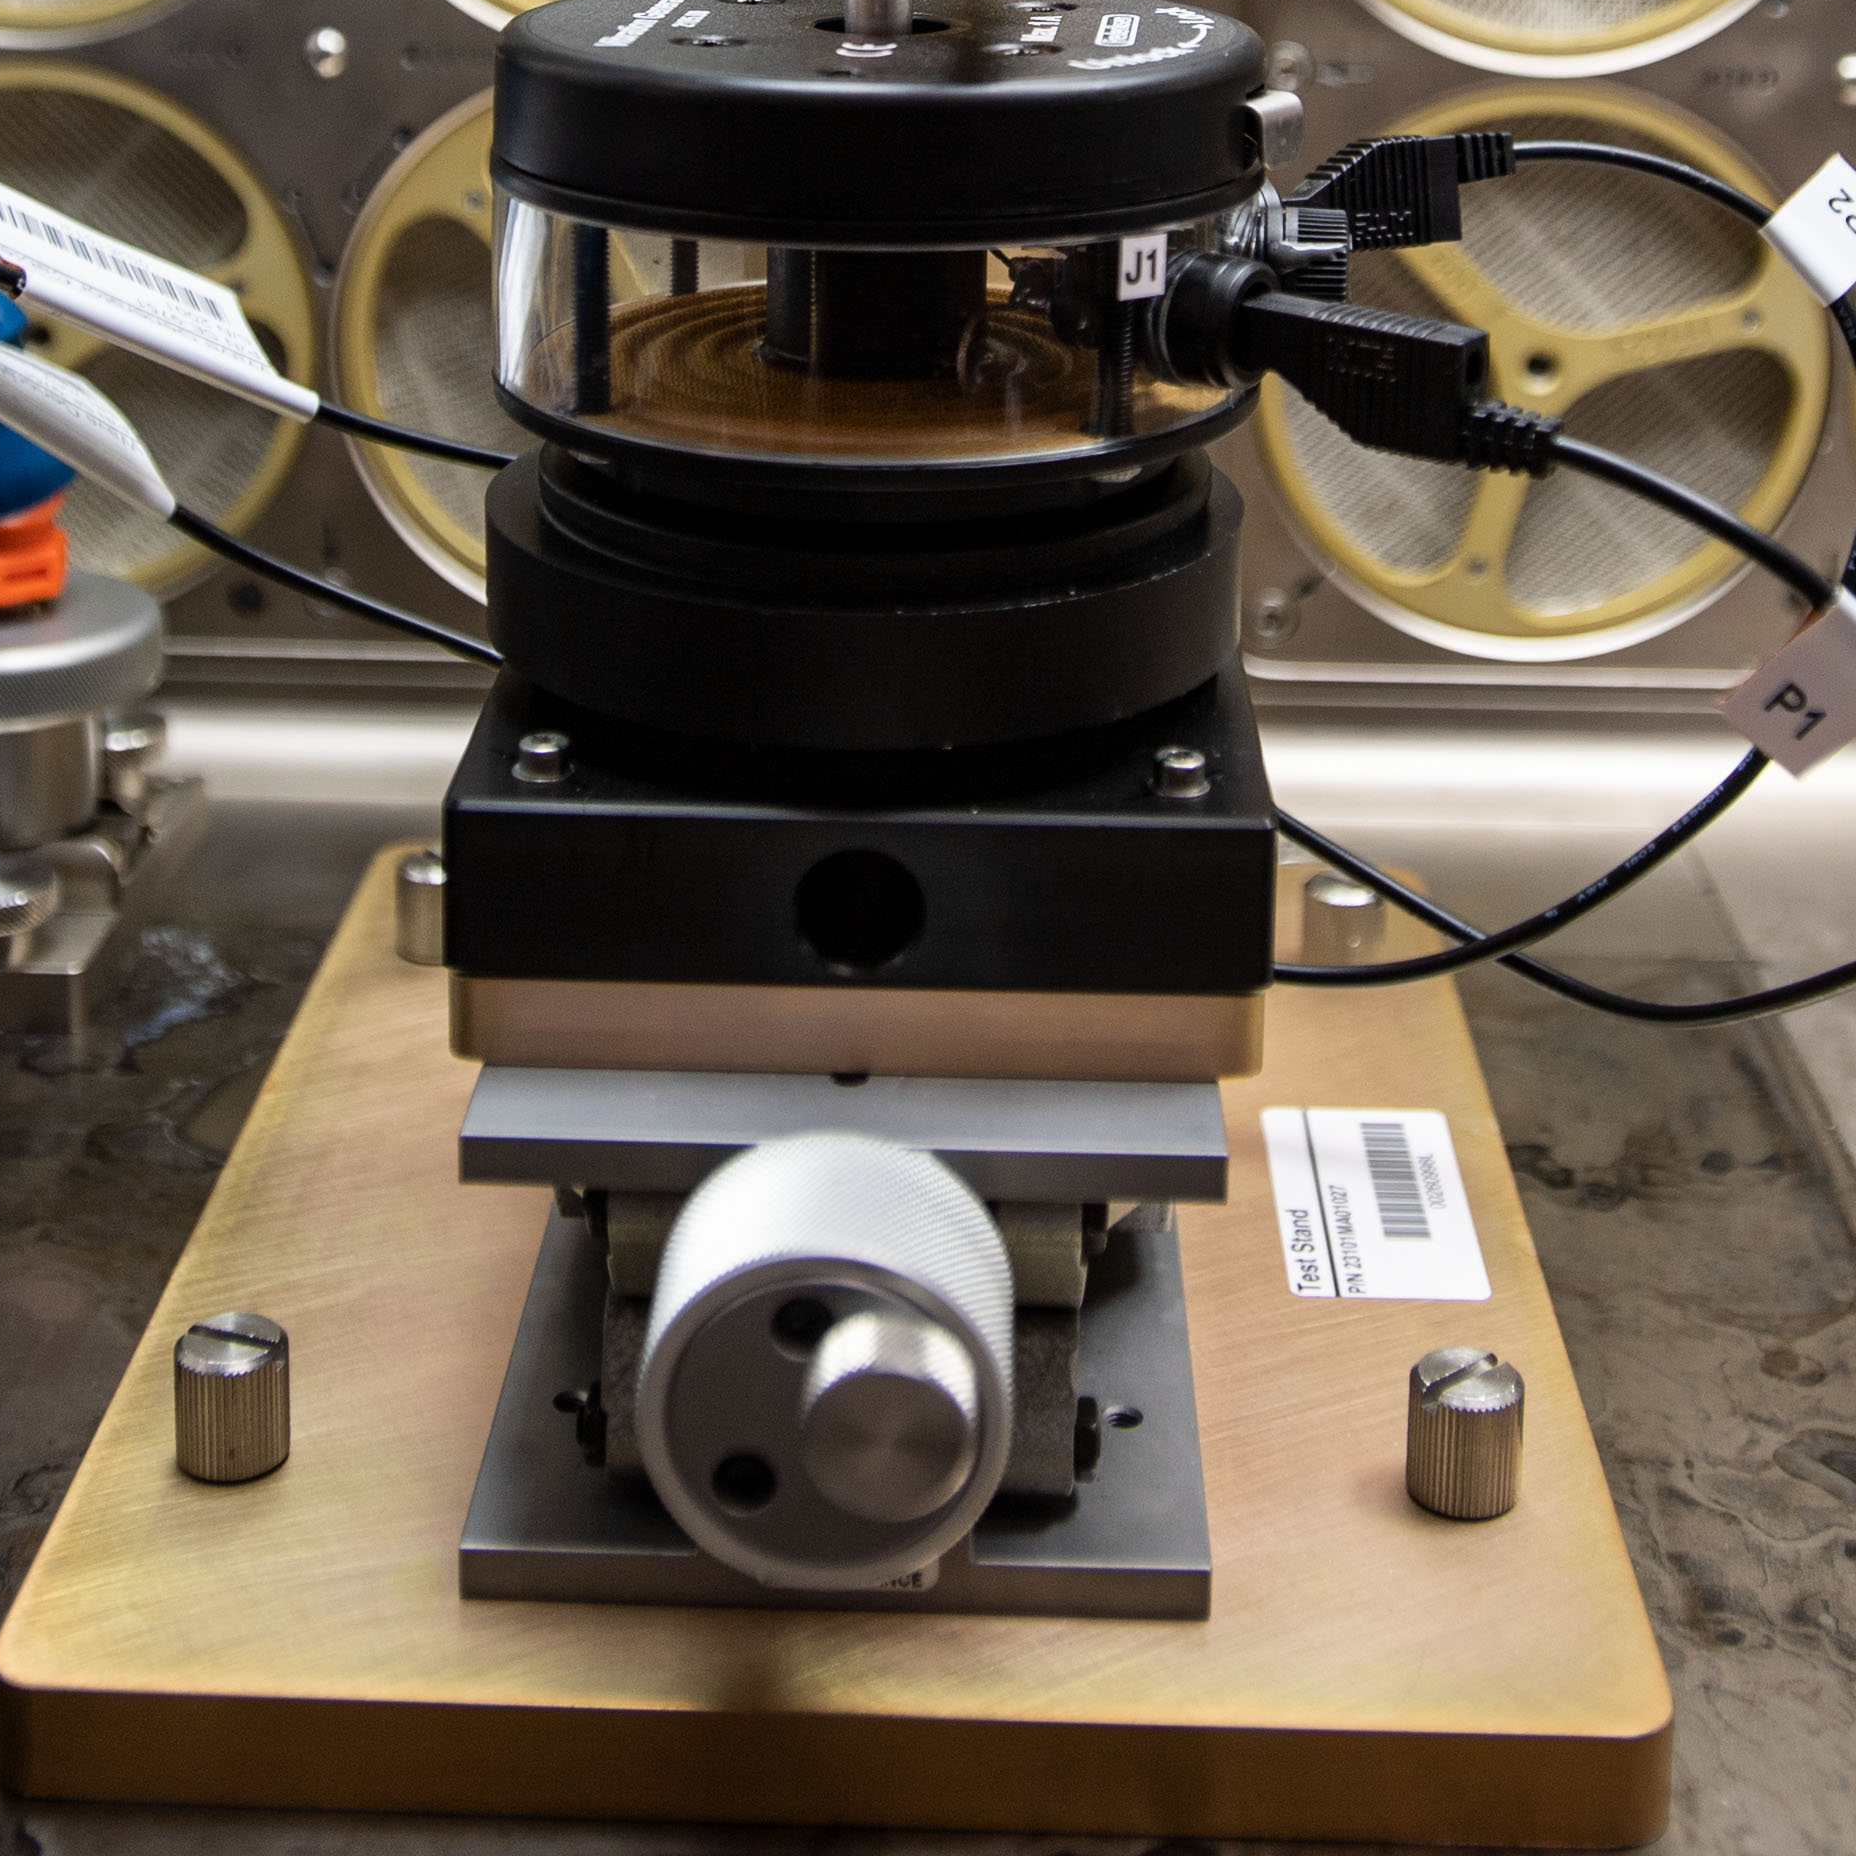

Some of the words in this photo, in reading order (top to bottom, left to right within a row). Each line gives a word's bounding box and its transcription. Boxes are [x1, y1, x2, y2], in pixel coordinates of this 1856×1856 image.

[1123, 248, 1160, 285] J1
[1762, 682, 1829, 742] P1
[1284, 1208, 1316, 1254] Stand
[1295, 1257, 1323, 1294] Test
[1347, 1272, 1368, 1295] P/N
